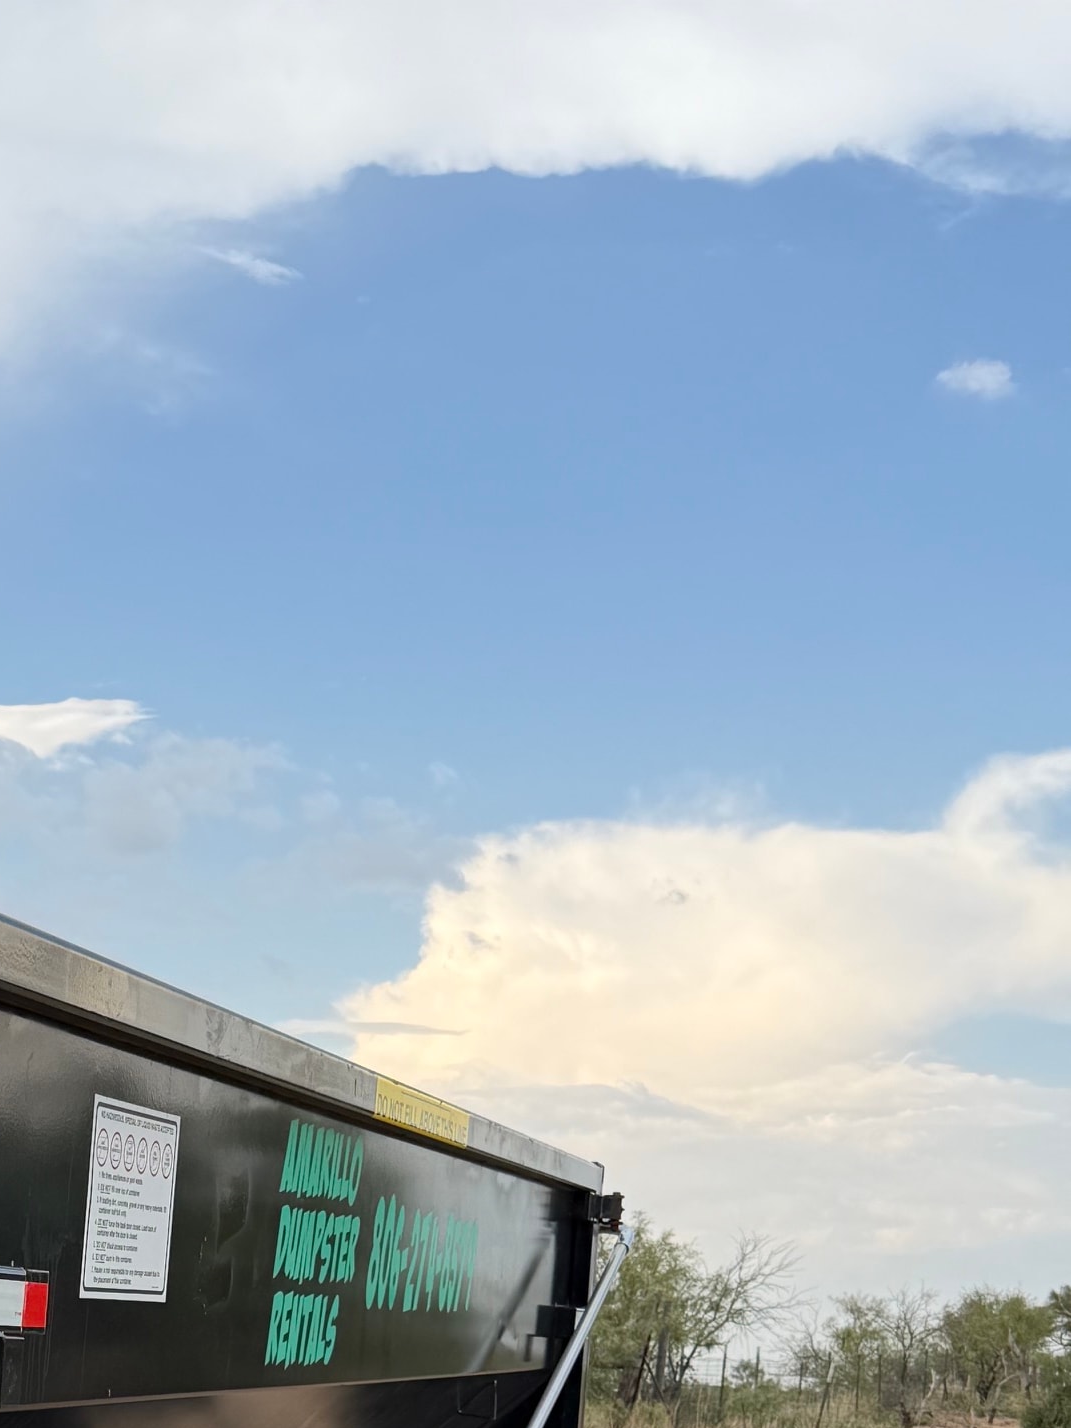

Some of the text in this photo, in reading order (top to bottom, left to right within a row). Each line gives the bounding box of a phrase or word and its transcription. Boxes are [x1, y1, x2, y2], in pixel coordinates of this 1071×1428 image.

[279, 1118, 364, 1207] AMARILLO
[272, 1204, 361, 1285] DUMPSTER
[264, 1290, 340, 1370] RENTALS
